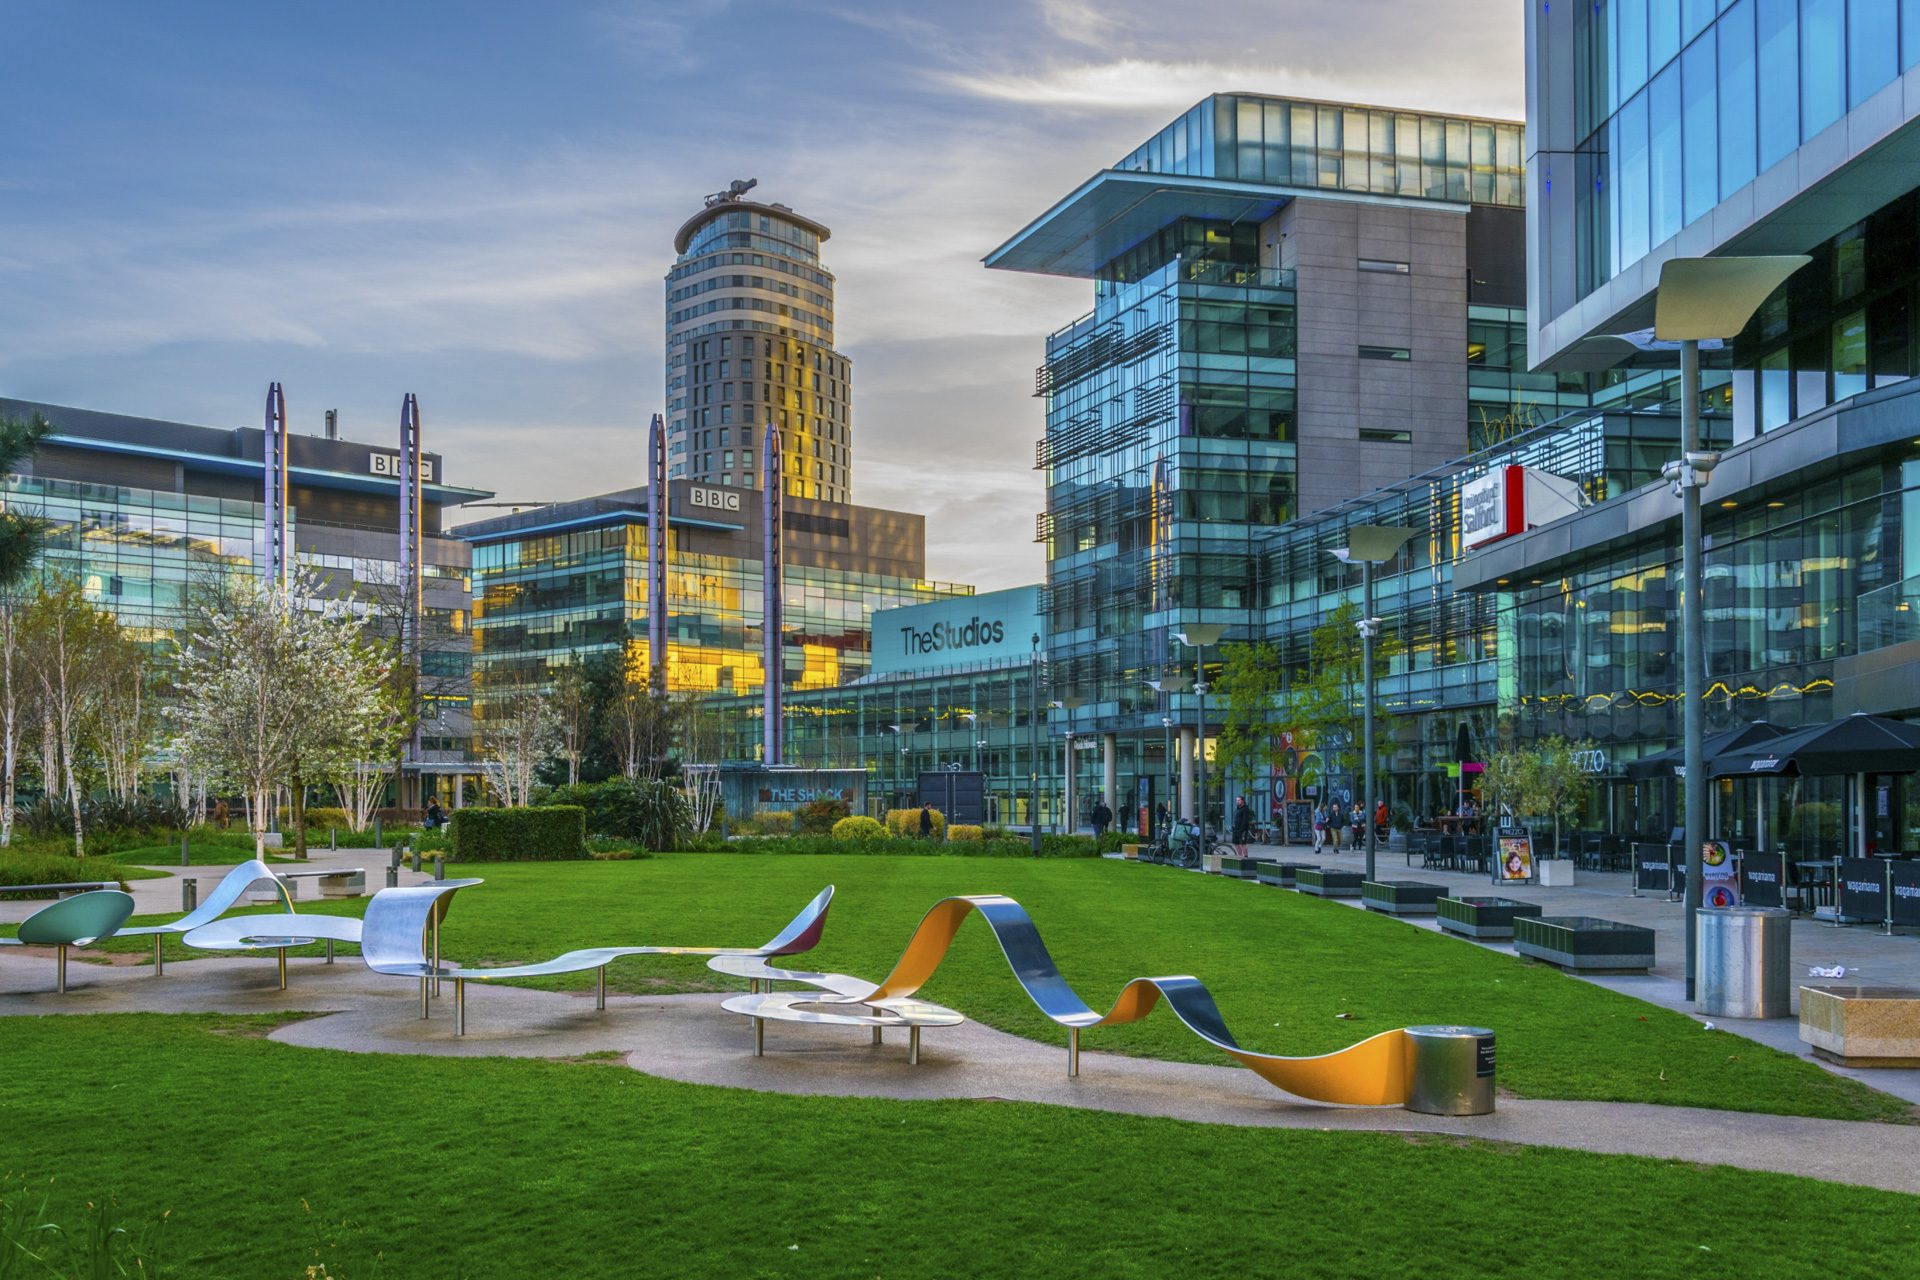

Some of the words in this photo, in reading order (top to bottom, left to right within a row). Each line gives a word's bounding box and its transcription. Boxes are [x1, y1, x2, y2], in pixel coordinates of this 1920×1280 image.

[374, 456, 430, 478] BC
[694, 489, 738, 509] BBC
[1463, 499, 1500, 534] Salford
[901, 616, 1004, 656] TheStudios
[771, 789, 796, 802] THE
[1847, 880, 1880, 893] wagamama
